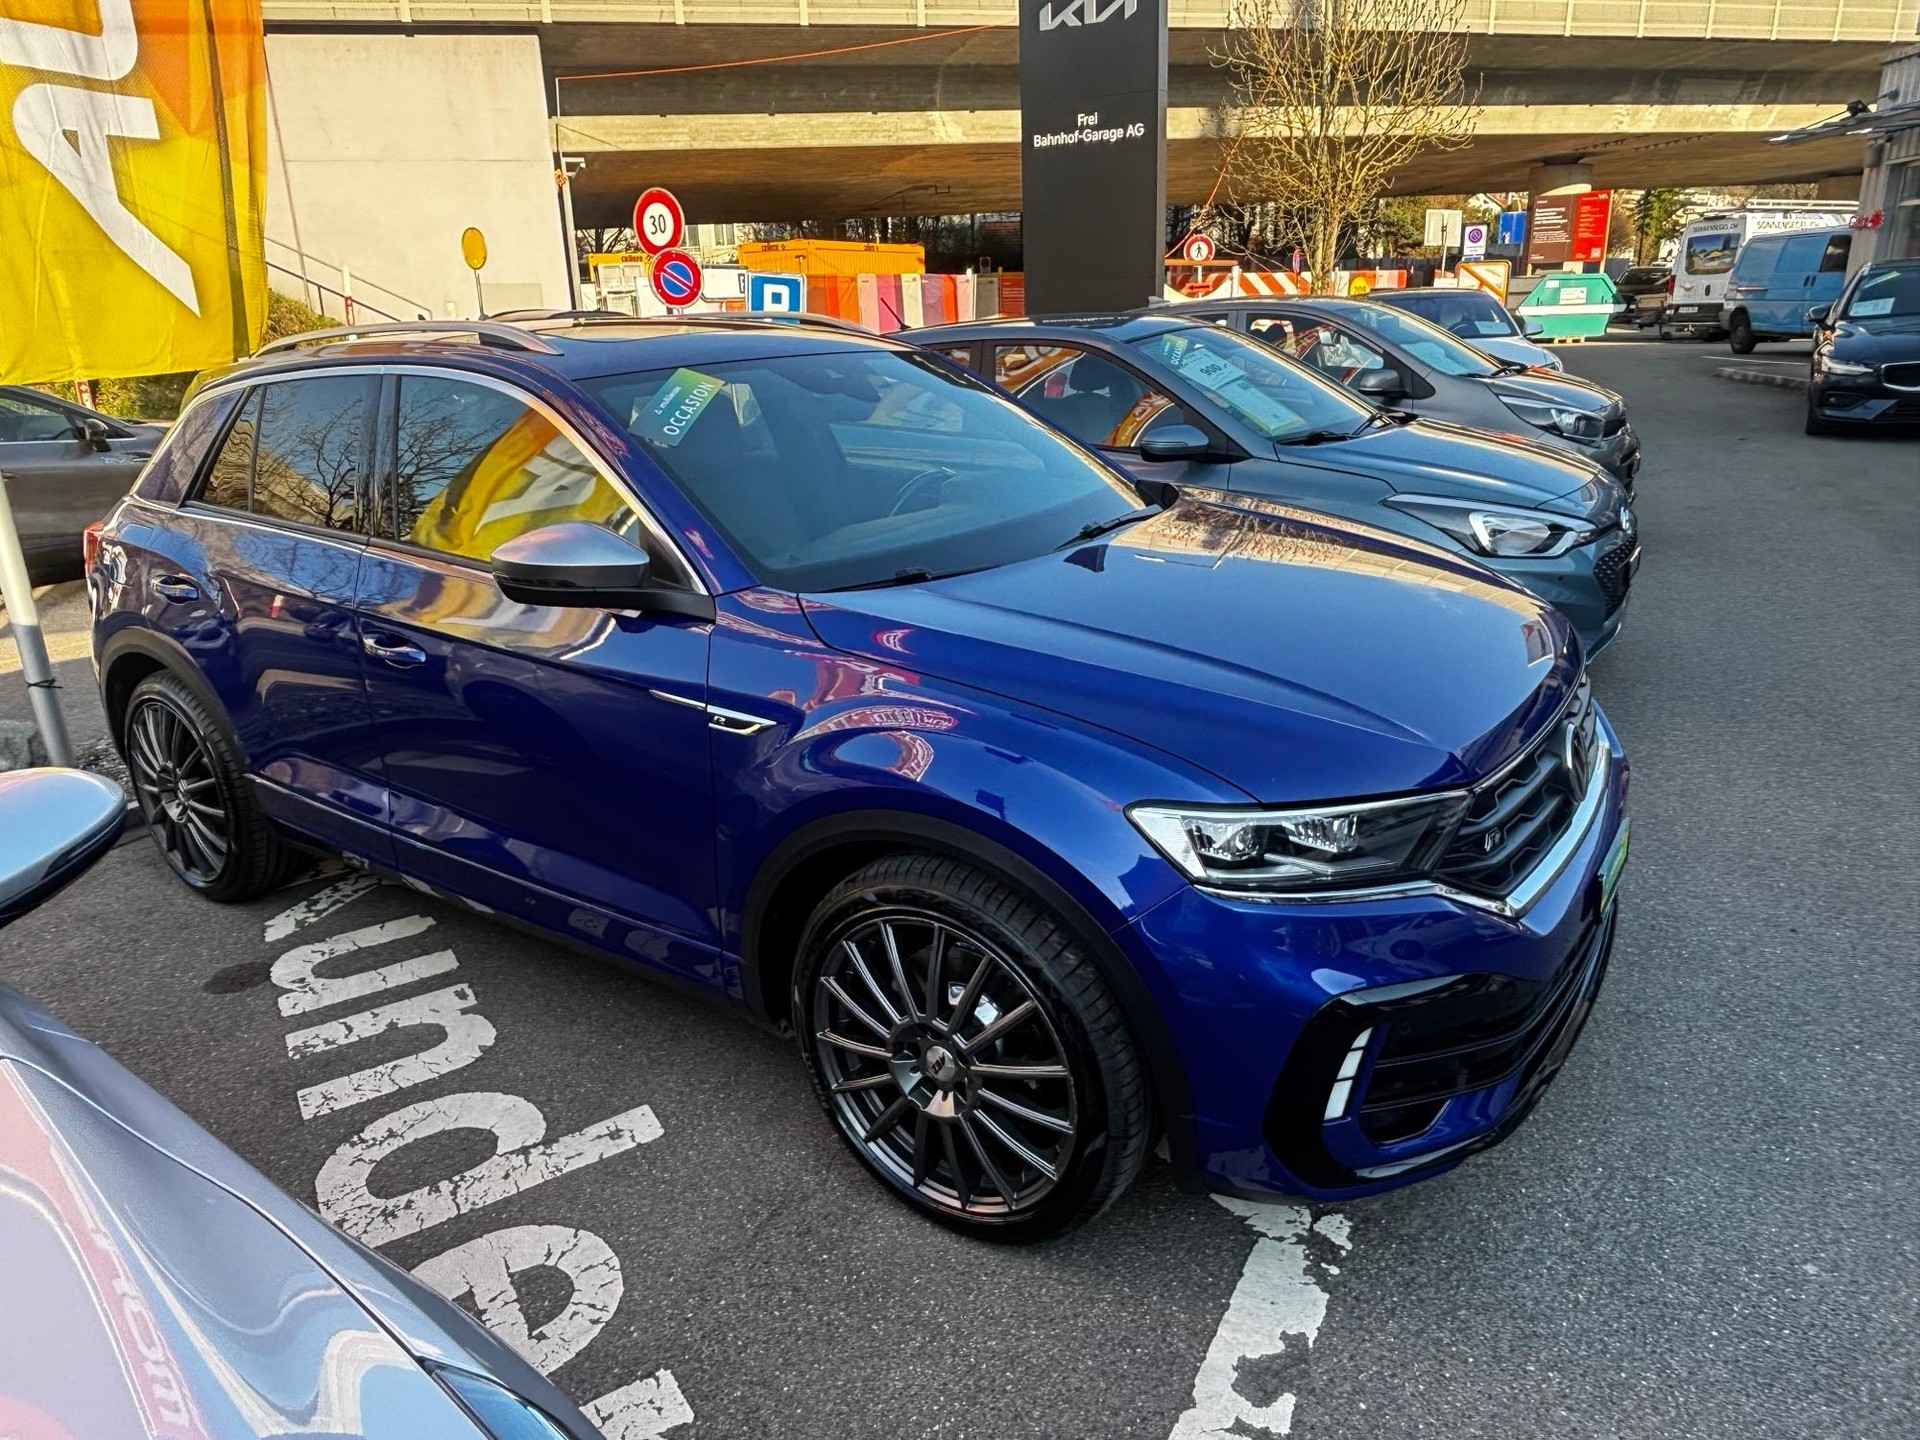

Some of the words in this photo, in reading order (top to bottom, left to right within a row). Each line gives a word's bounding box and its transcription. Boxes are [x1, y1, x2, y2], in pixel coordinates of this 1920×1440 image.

[1077, 111, 1098, 127] Frei
[1033, 127, 1124, 148] Bahnhof-Garage
[1126, 122, 1145, 138] AG
[649, 214, 667, 235] 30
[763, 283, 790, 312] P
[663, 381, 716, 436] OCCASION
[264, 872, 695, 1440] unde
